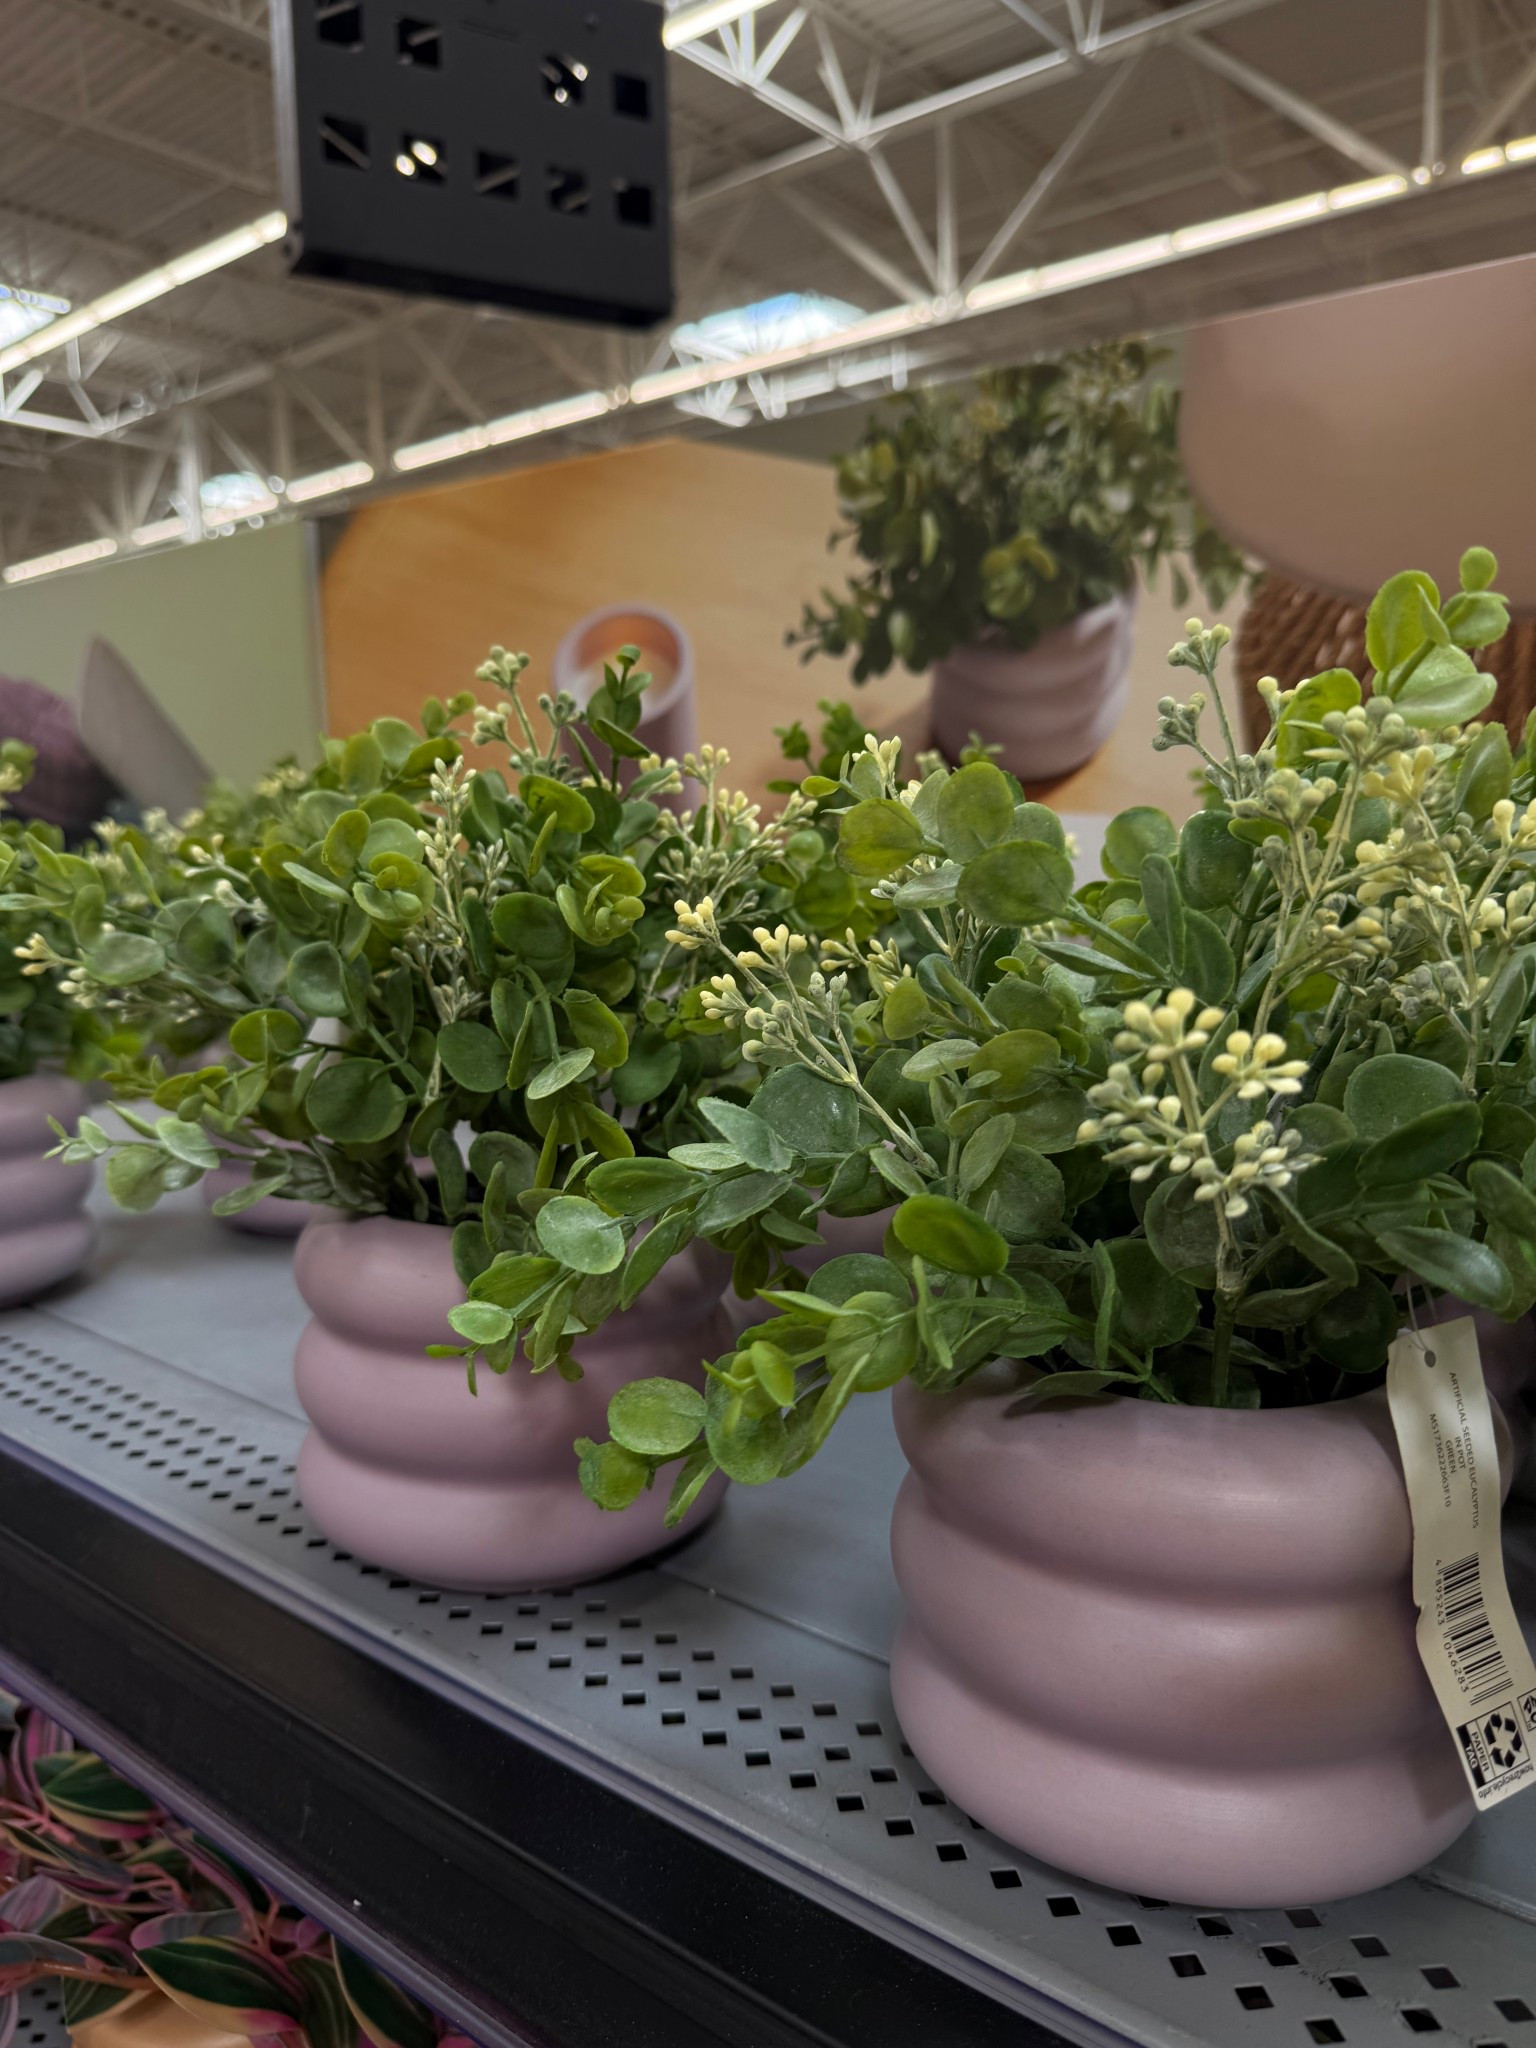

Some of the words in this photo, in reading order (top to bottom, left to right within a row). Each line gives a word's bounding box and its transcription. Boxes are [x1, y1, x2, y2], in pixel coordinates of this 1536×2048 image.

[1445, 1440, 1457, 1474] GREEN
[1449, 1372, 1467, 1425] ARTIFICIAL
[1462, 1426, 1475, 1465] SEEDED
[1469, 1466, 1479, 1529] EUCALYPTUS
[1455, 1436, 1462, 1448] IN
[1457, 1450, 1466, 1469] POT
[1436, 1578, 1445, 1626] 895243
[1443, 1642, 1469, 1693] 046283
[1464, 1744, 1478, 1769] TAG
[1471, 1731, 1490, 1772] PAPER
